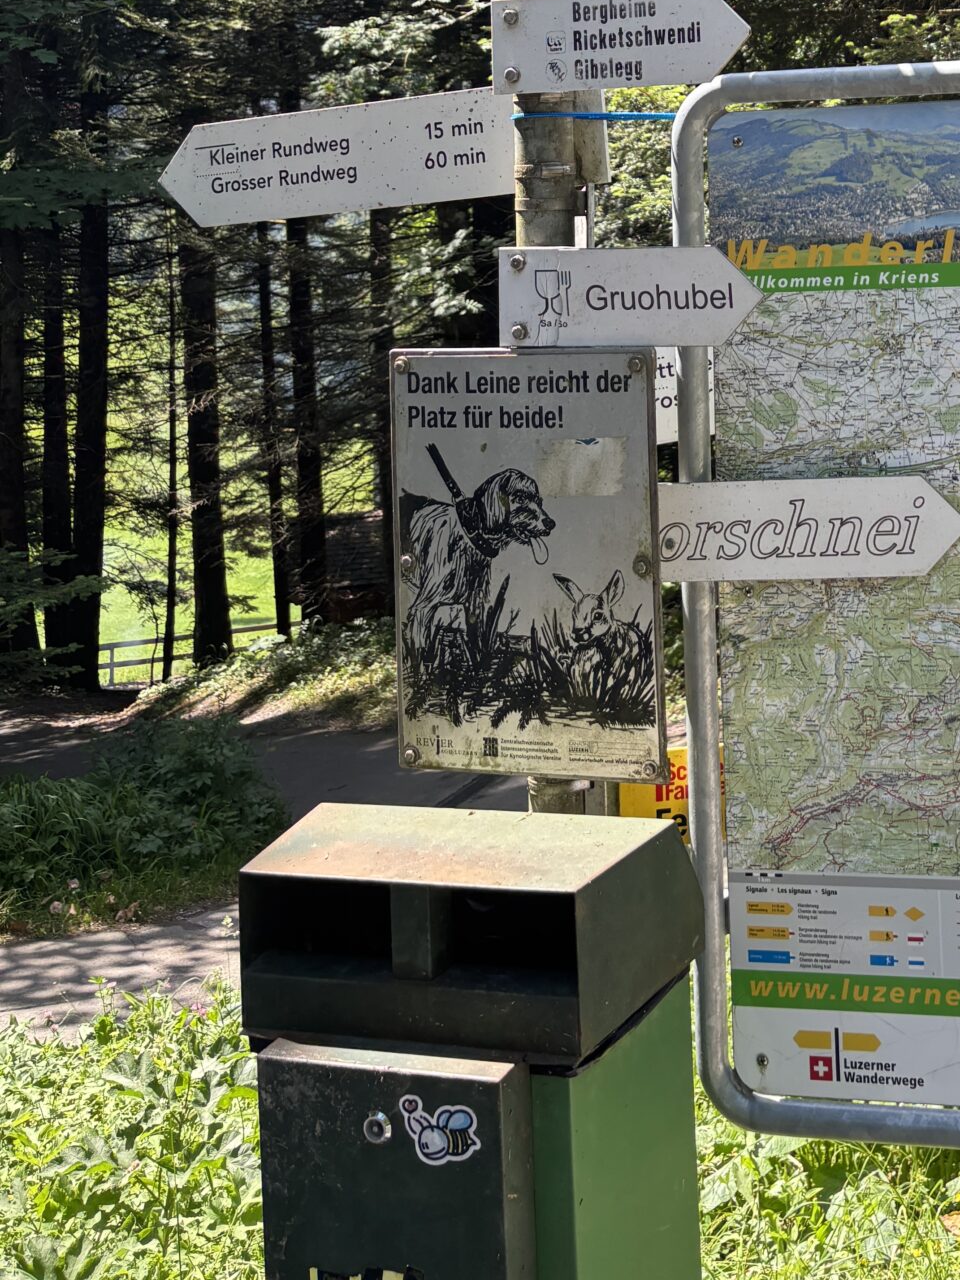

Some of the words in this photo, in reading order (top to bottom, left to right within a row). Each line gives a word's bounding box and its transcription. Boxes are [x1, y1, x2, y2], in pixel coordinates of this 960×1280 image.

[573, 0, 656, 24] Bergheime
[573, 22, 701, 51] Ricketschwendi
[575, 58, 643, 81] Gibelegg
[210, 146, 266, 167] Kleiner
[272, 136, 350, 160] Rundweg
[425, 122, 444, 140] 15
[452, 120, 484, 137] min
[211, 175, 273, 195] Grosser
[279, 164, 357, 188] Rundweg
[425, 152, 447, 170] 60
[454, 148, 486, 166] min
[748, 275, 844, 289] llkommen
[853, 272, 870, 286] in
[879, 271, 939, 285] Kriens
[586, 282, 733, 311] Gruohubel
[408, 372, 459, 394] Dank
[465, 372, 520, 394] Leine
[527, 370, 590, 394] reicht
[596, 371, 632, 393] der
[408, 405, 457, 428] Platz
[463, 406, 493, 428] für
[500, 406, 564, 429] beide!
[659, 496, 925, 562] orschnei
[844, 1058, 896, 1071] Luzerner
[844, 1072, 924, 1089] Wanderwege
